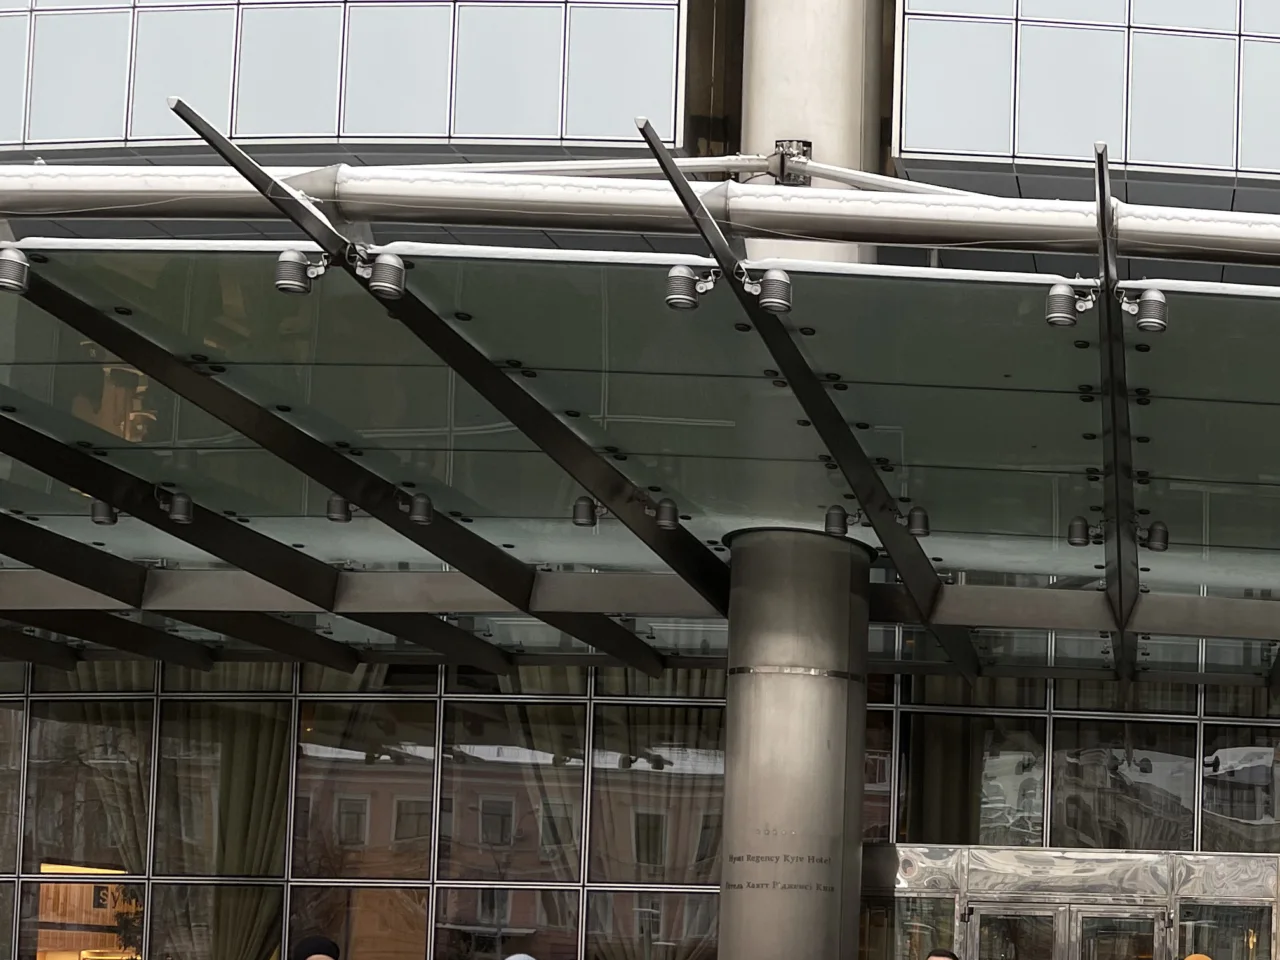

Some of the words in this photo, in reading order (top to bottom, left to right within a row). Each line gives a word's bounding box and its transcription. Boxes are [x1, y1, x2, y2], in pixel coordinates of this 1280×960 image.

[746, 854, 780, 863] Regency
[783, 854, 805, 864] Kyiv
[807, 855, 832, 865] Hotel
